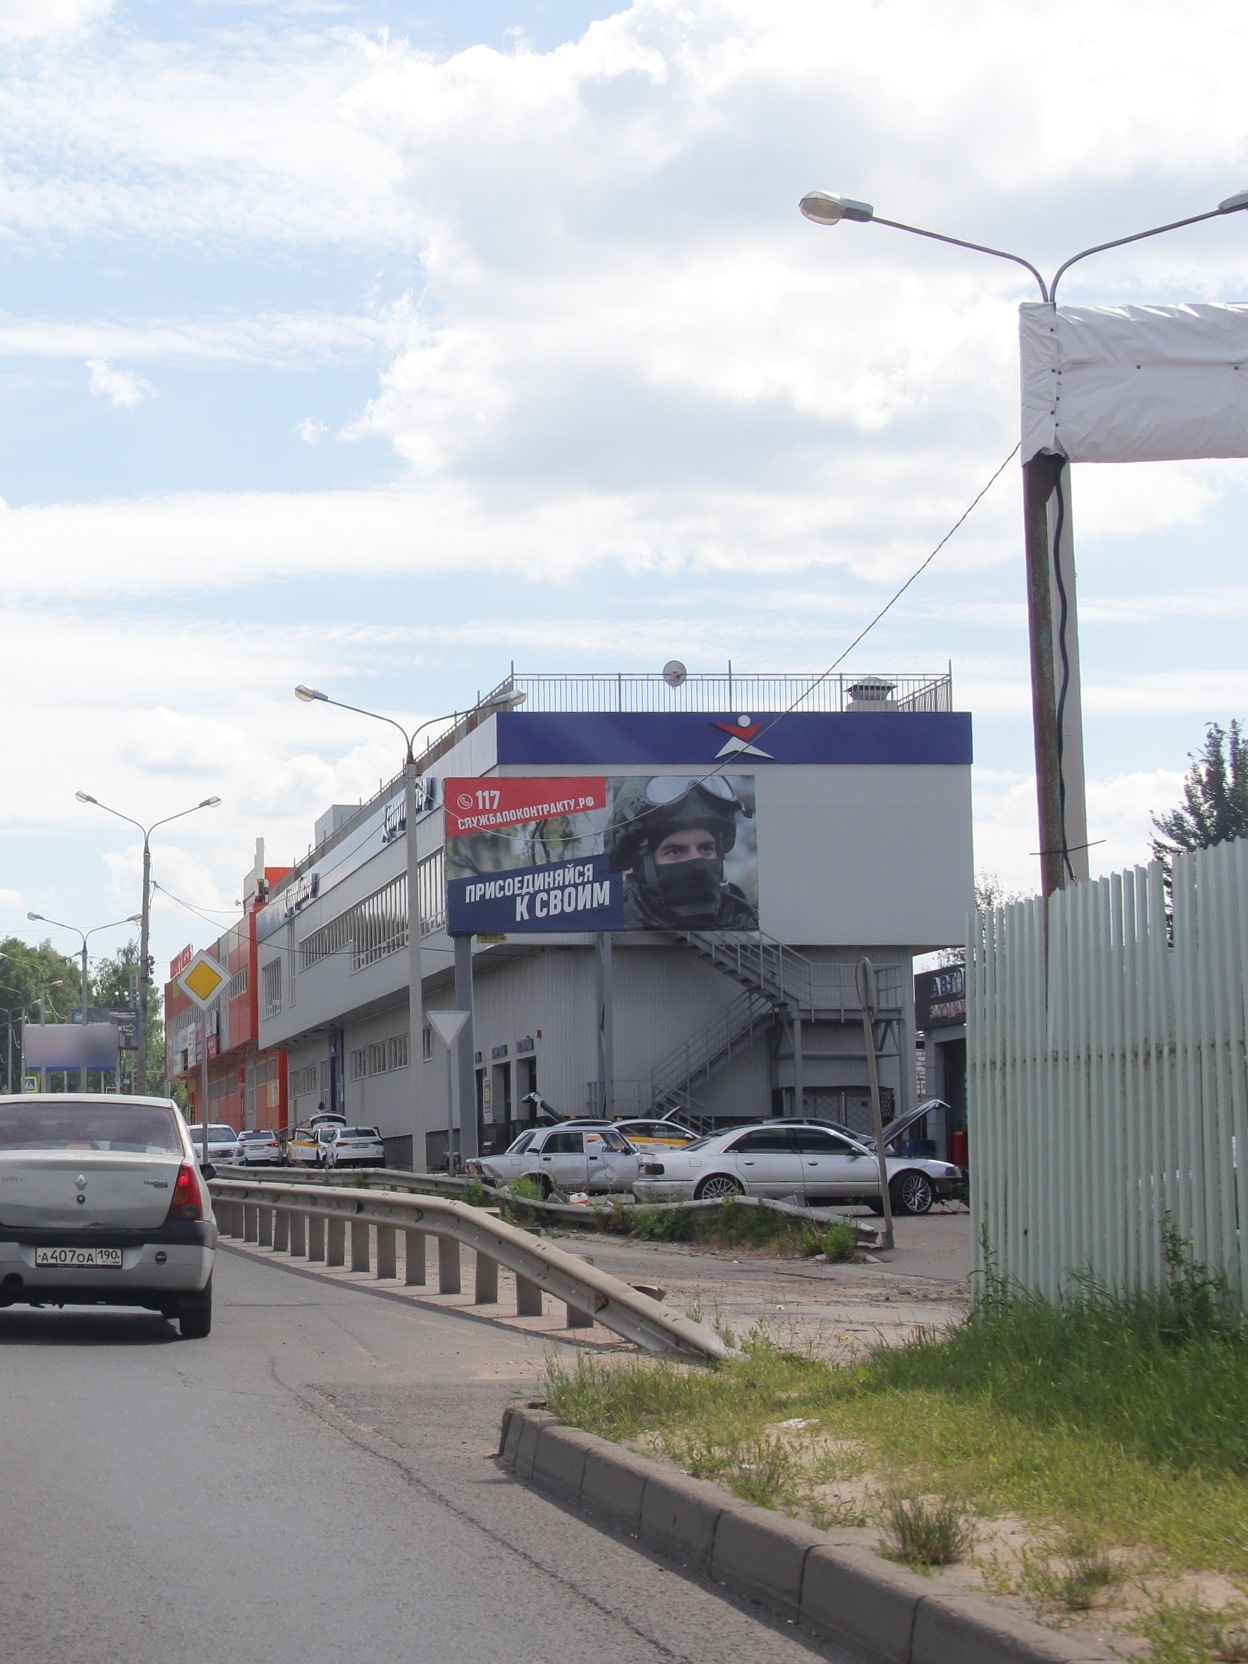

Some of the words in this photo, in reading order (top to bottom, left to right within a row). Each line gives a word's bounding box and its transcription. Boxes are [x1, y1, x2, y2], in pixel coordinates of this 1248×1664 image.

[457, 796, 595, 830] СЛУЖБАПОКОНТРАКТУ.РФ
[475, 790, 501, 810] 117
[465, 863, 594, 904] ПРИСОЕДИНЯЙСЯ
[515, 895, 530, 922] К
[535, 880, 611, 917] СВОИМ
[97, 1250, 118, 1260] 190
